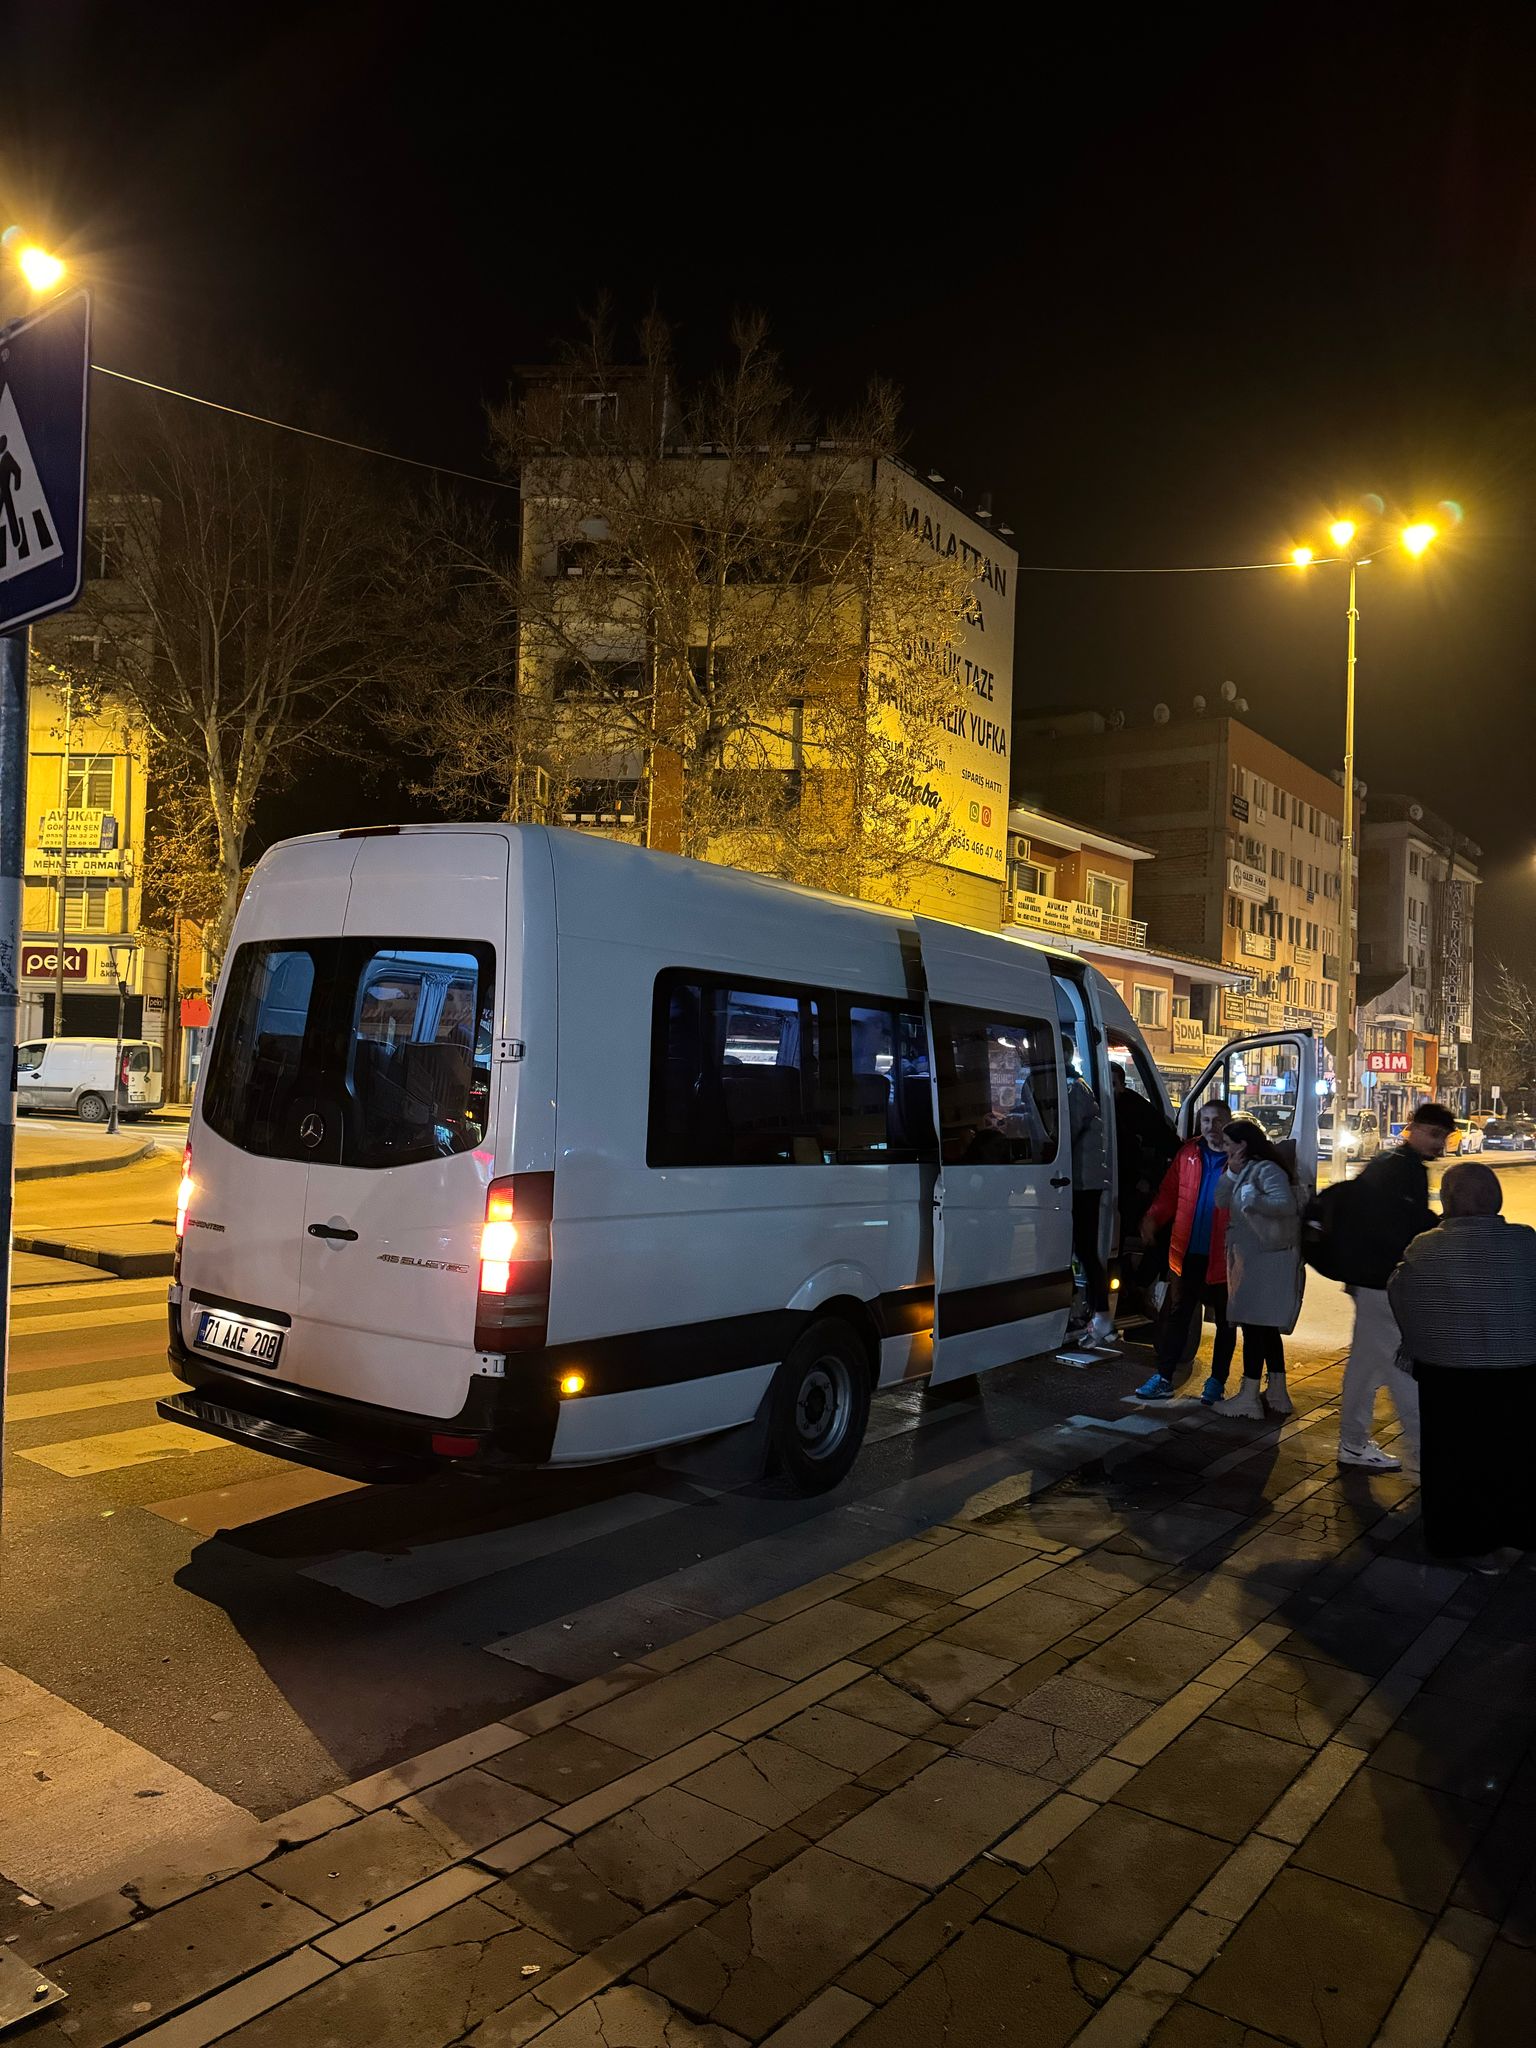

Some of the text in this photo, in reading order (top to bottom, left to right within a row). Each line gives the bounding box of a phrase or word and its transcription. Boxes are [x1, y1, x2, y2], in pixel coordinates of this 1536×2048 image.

[964, 659, 994, 702] TAZE
[969, 711, 1006, 758] YUFKA
[961, 767, 1002, 794] SİPARİŞ HATTI
[83, 824, 100, 833] ŞEN
[971, 841, 984, 856] 466
[985, 846, 993, 858] 47
[994, 849, 1003, 862] 48
[33, 860, 121, 870] MEHMET ORMAN
[1046, 902, 1069, 913] AVUKAT
[1075, 904, 1099, 919] AVUKAT
[26, 951, 81, 975] peki
[99, 961, 119, 970] baby
[99, 970, 121, 978] &kids
[148, 998, 162, 1008] peki
[1181, 1023, 1202, 1041] DNA
[1371, 1052, 1408, 1070] BİM
[204, 1318, 278, 1359] 71 AAE 208
